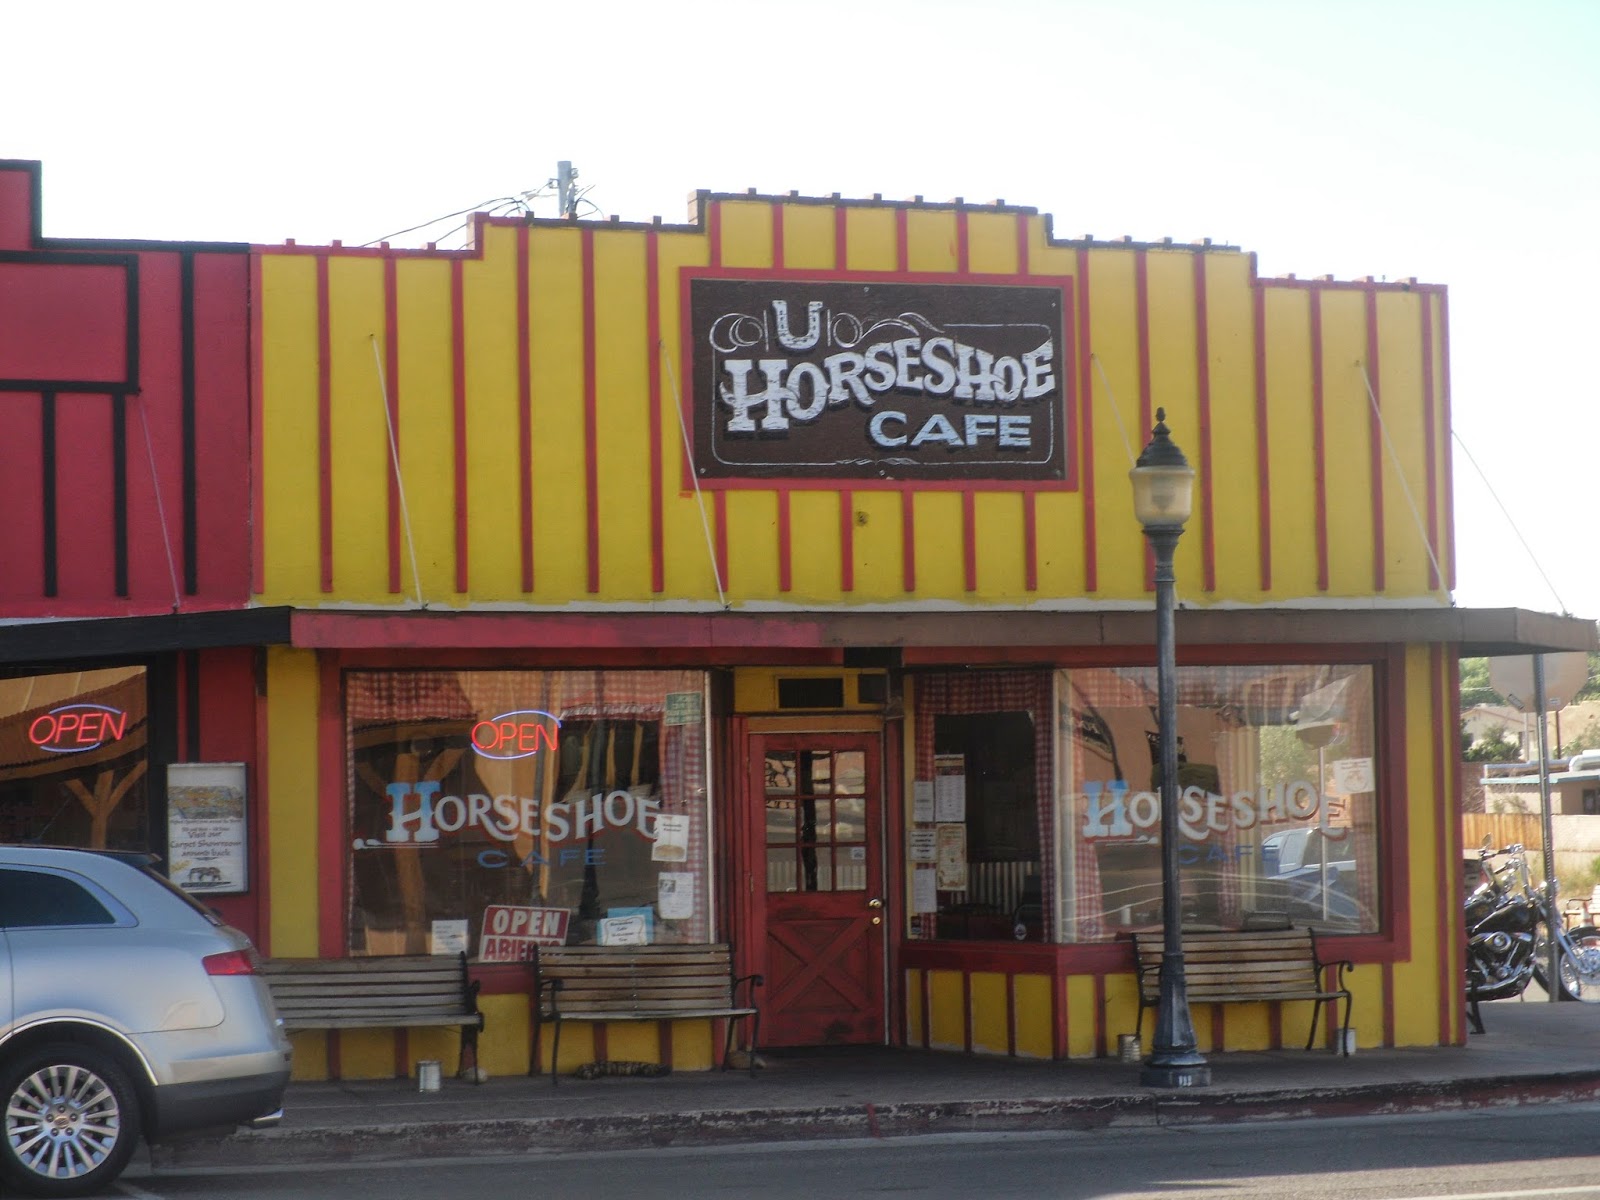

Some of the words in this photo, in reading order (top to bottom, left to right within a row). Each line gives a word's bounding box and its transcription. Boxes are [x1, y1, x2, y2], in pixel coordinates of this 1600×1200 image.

[720, 337, 1054, 432] HORSESHOE
[868, 410, 1032, 447] CAFE
[28, 711, 127, 745] OPEN
[471, 720, 558, 751] OPEN
[386, 781, 660, 842] HORSESHOE
[170, 840, 196, 850] Carpet
[198, 840, 242, 848] Showroom
[477, 849, 607, 868] CAFE
[1178, 844, 1281, 866] CAFE
[492, 908, 562, 936] OPEN
[483, 937, 561, 963] ABIER
